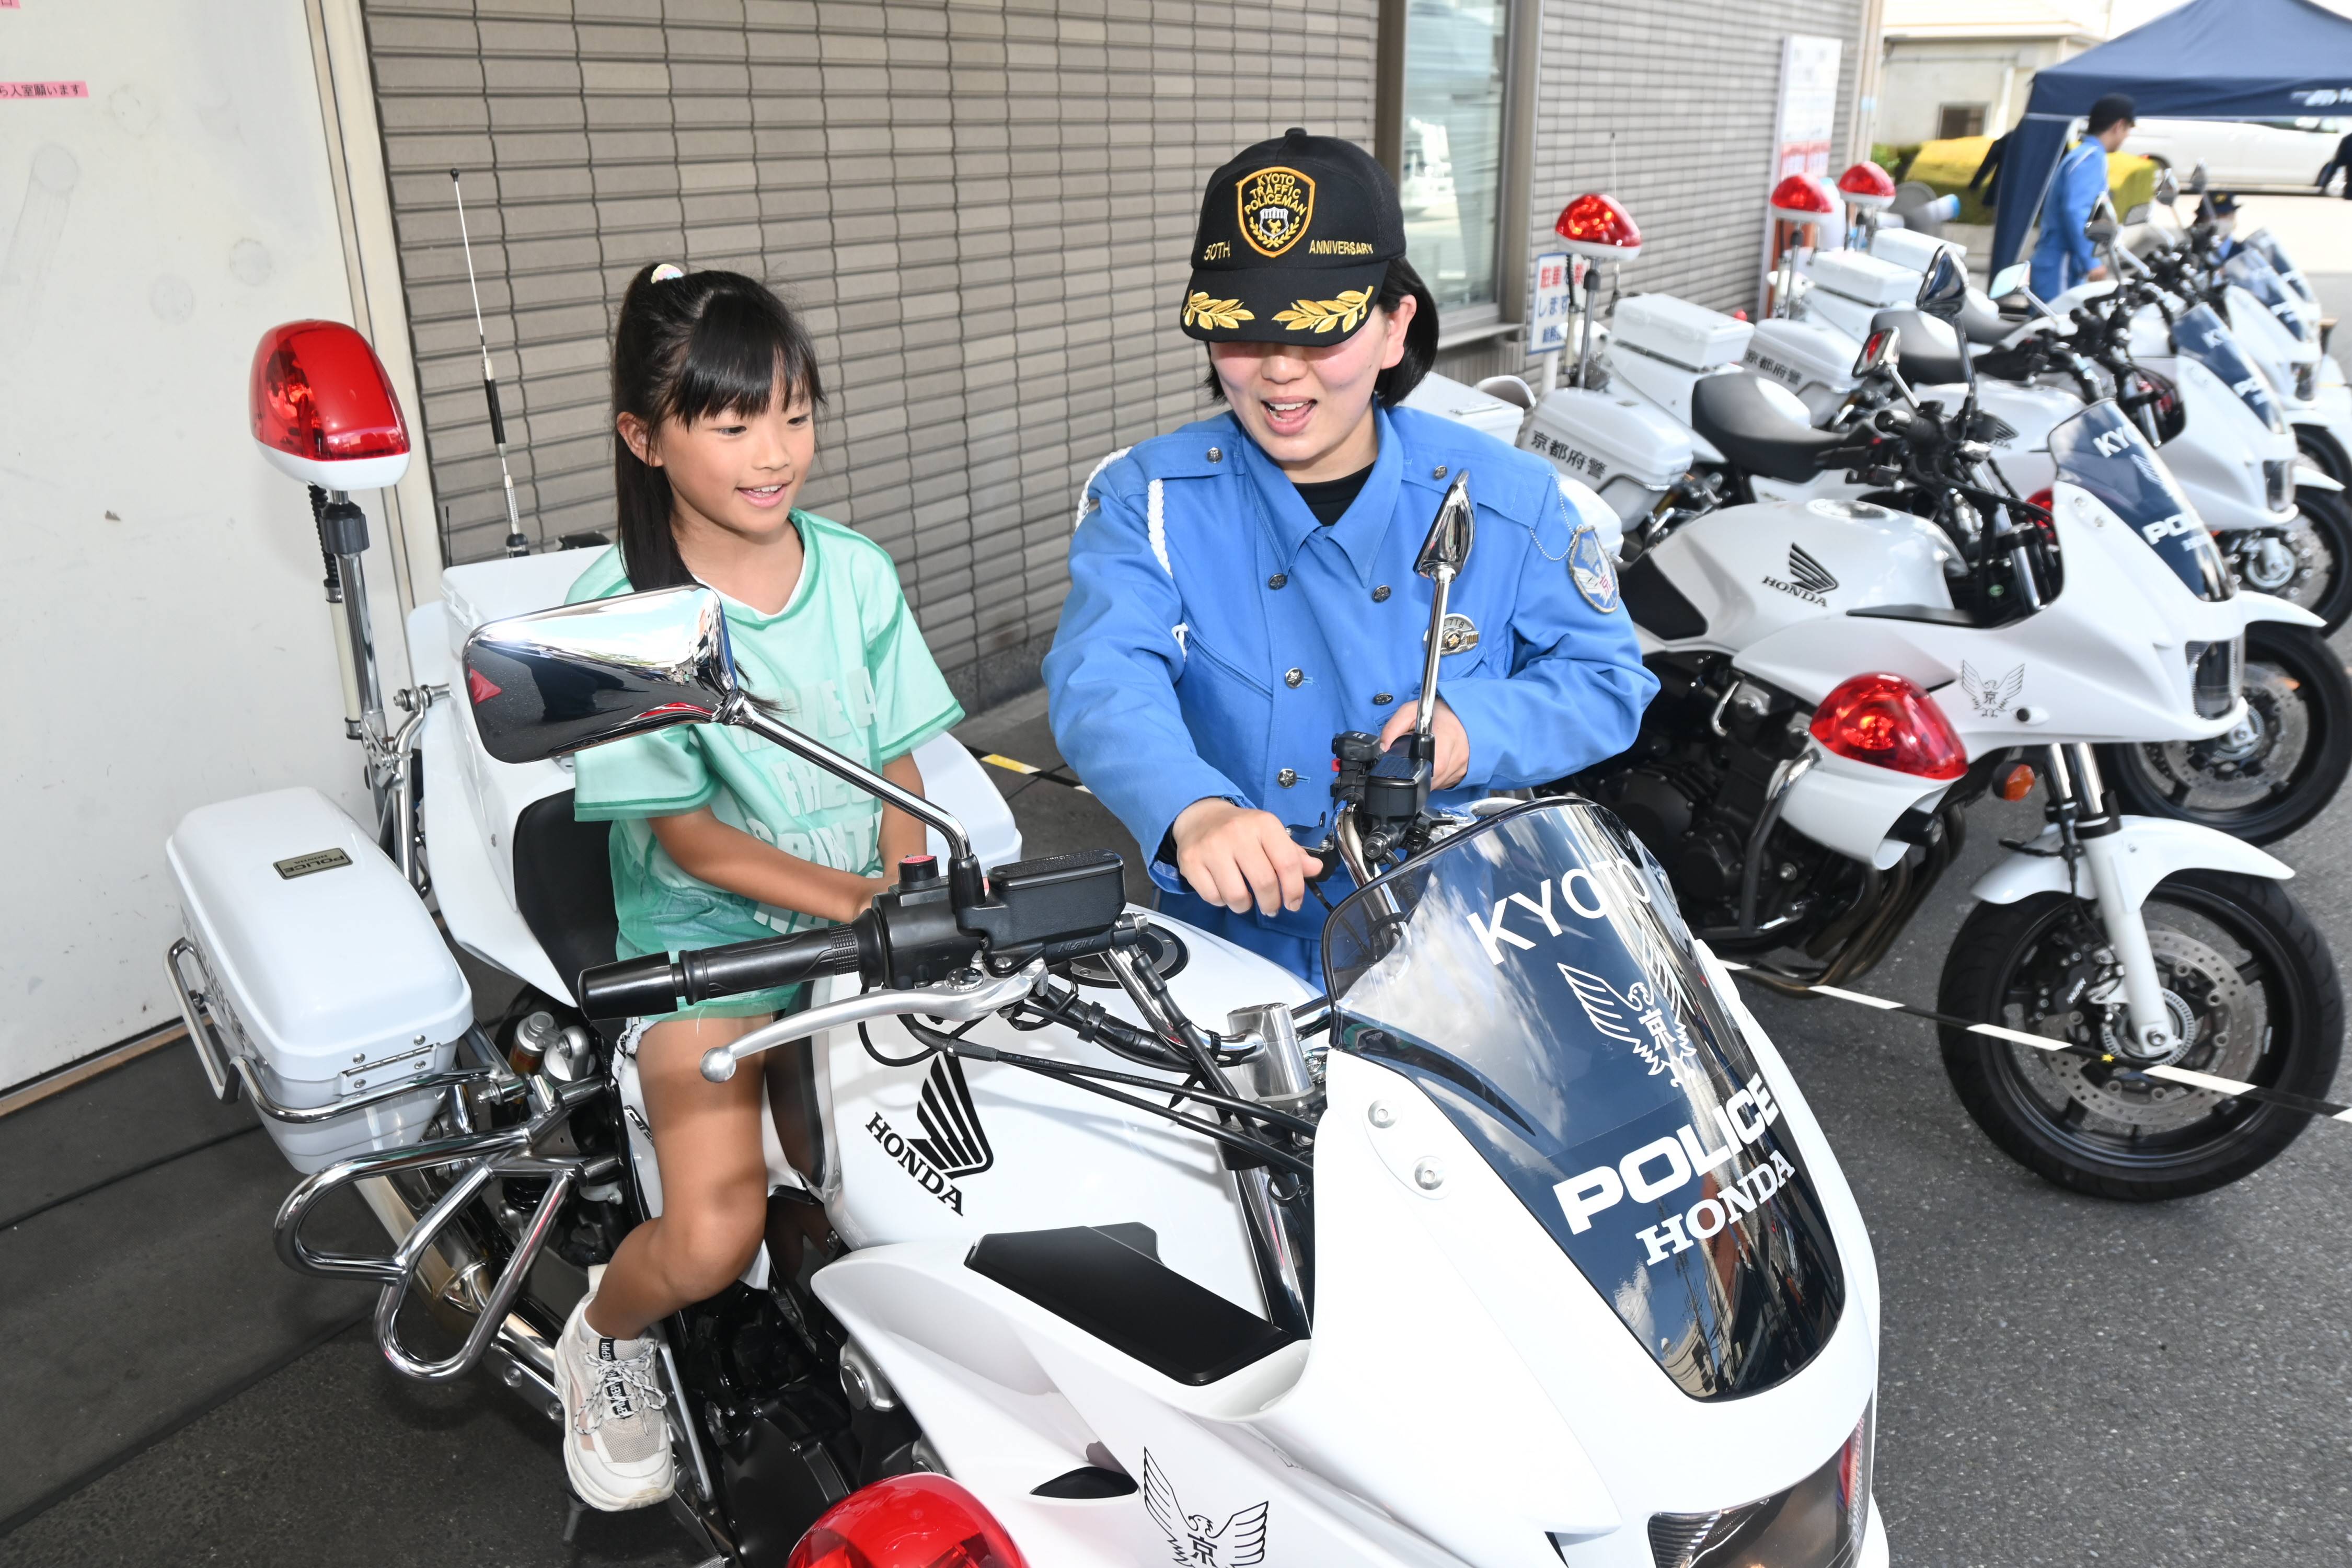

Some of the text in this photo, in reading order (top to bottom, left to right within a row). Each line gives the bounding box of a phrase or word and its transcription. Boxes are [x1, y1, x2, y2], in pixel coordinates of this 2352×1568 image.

[1250, 184, 1301, 199] TRAFFIC
[1256, 173, 1295, 186] KYOTO
[1244, 194, 1307, 216] POLICEMAN
[1204, 240, 1374, 260] 50TH ANNIVERSARY
[1531, 430, 1608, 480] 京都府警
[1762, 575, 1828, 607] HONDA
[283, 856, 345, 873] POLICE
[294, 855, 328, 864] HONDA
[1466, 858, 1651, 965] KYOTO
[865, 1112, 964, 1217] HONDA
[1553, 1072, 1779, 1236] POLICE
[1636, 1150, 1795, 1266] HONDA
